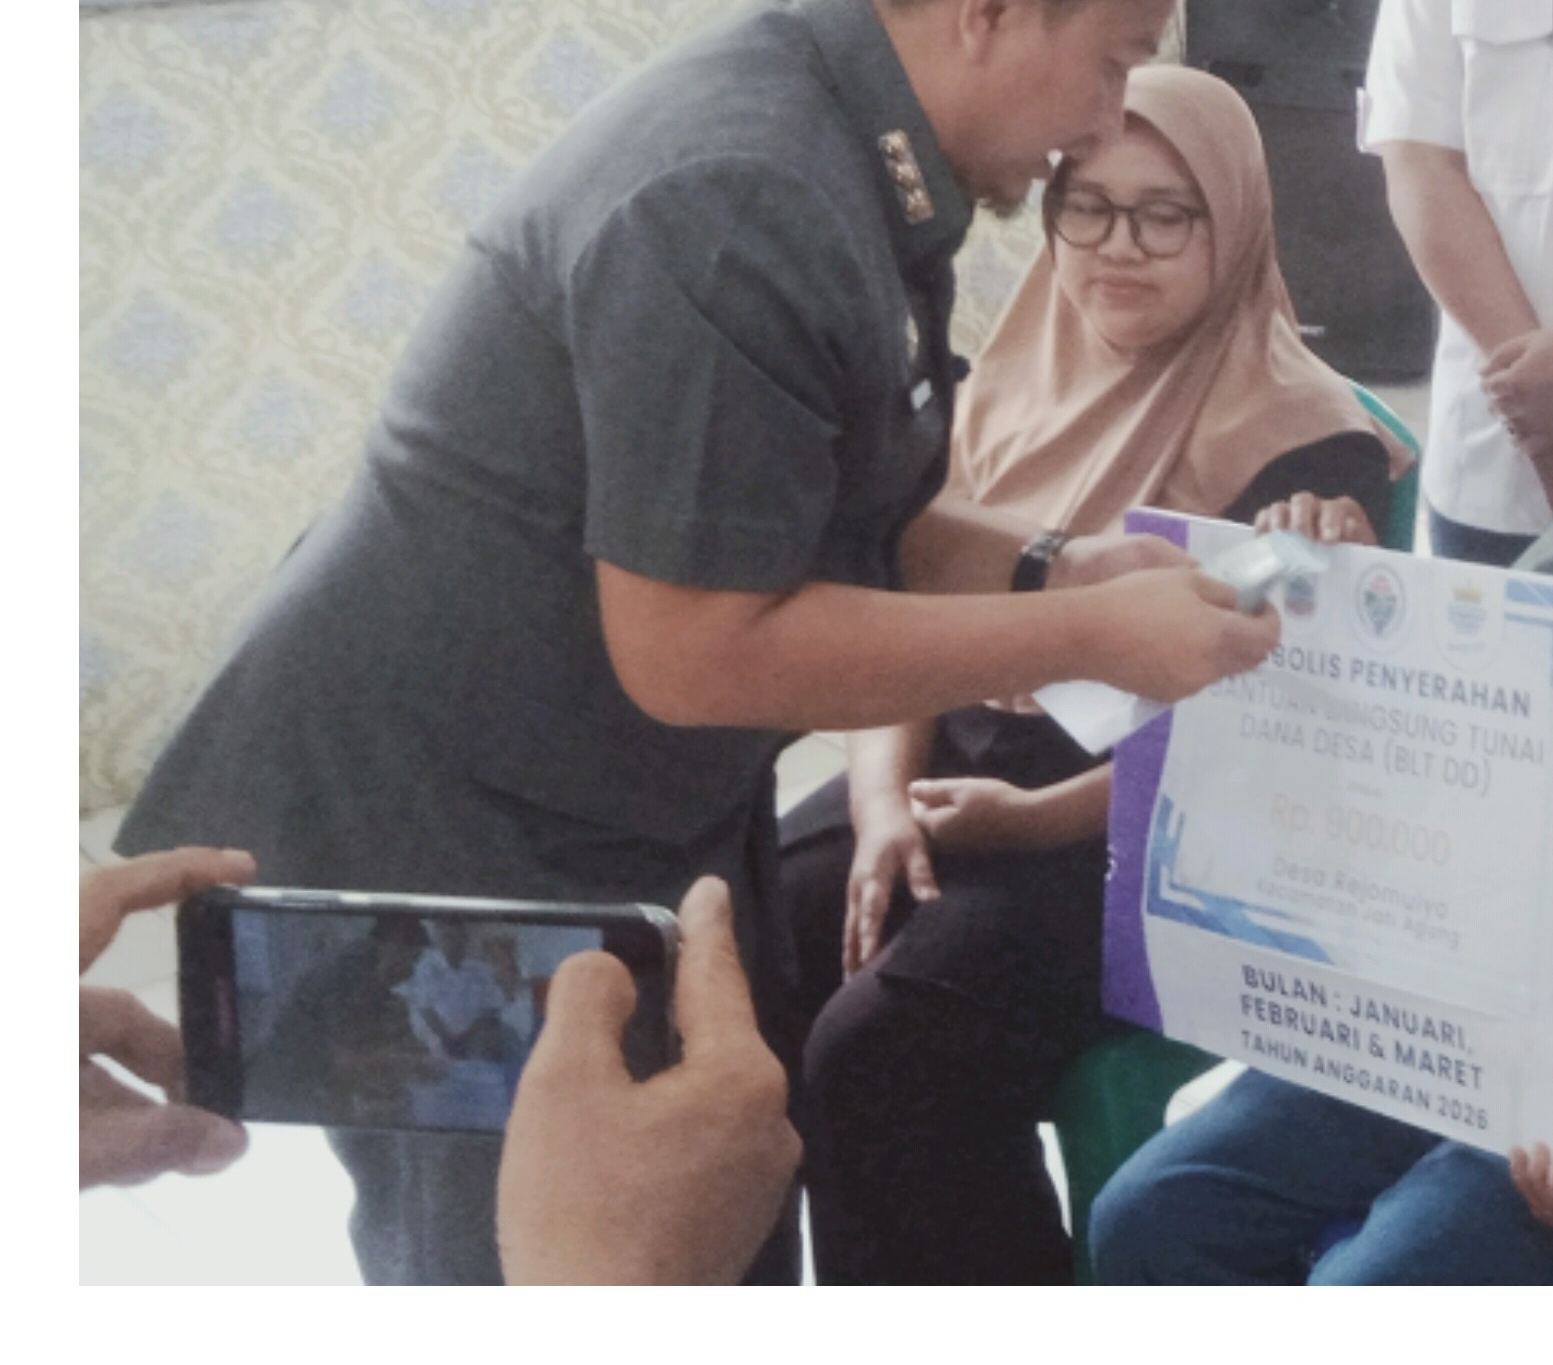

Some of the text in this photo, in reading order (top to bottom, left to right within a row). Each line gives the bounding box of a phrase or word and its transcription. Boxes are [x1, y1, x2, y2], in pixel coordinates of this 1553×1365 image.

[1268, 643, 1533, 720] BOLIS PENYERAHAN
[1240, 712, 1492, 800] DANA DESA (BLT DD)
[1467, 722, 1545, 767] TUNAI
[1272, 855, 1327, 888] Desa
[1240, 994, 1484, 1090] FEBRUARI & MARET
[1242, 965, 1328, 1007] BULAN
[1350, 995, 1475, 1056] JANUARI,
[1241, 1030, 1490, 1131] TAHUN ANGGARAN 2026
